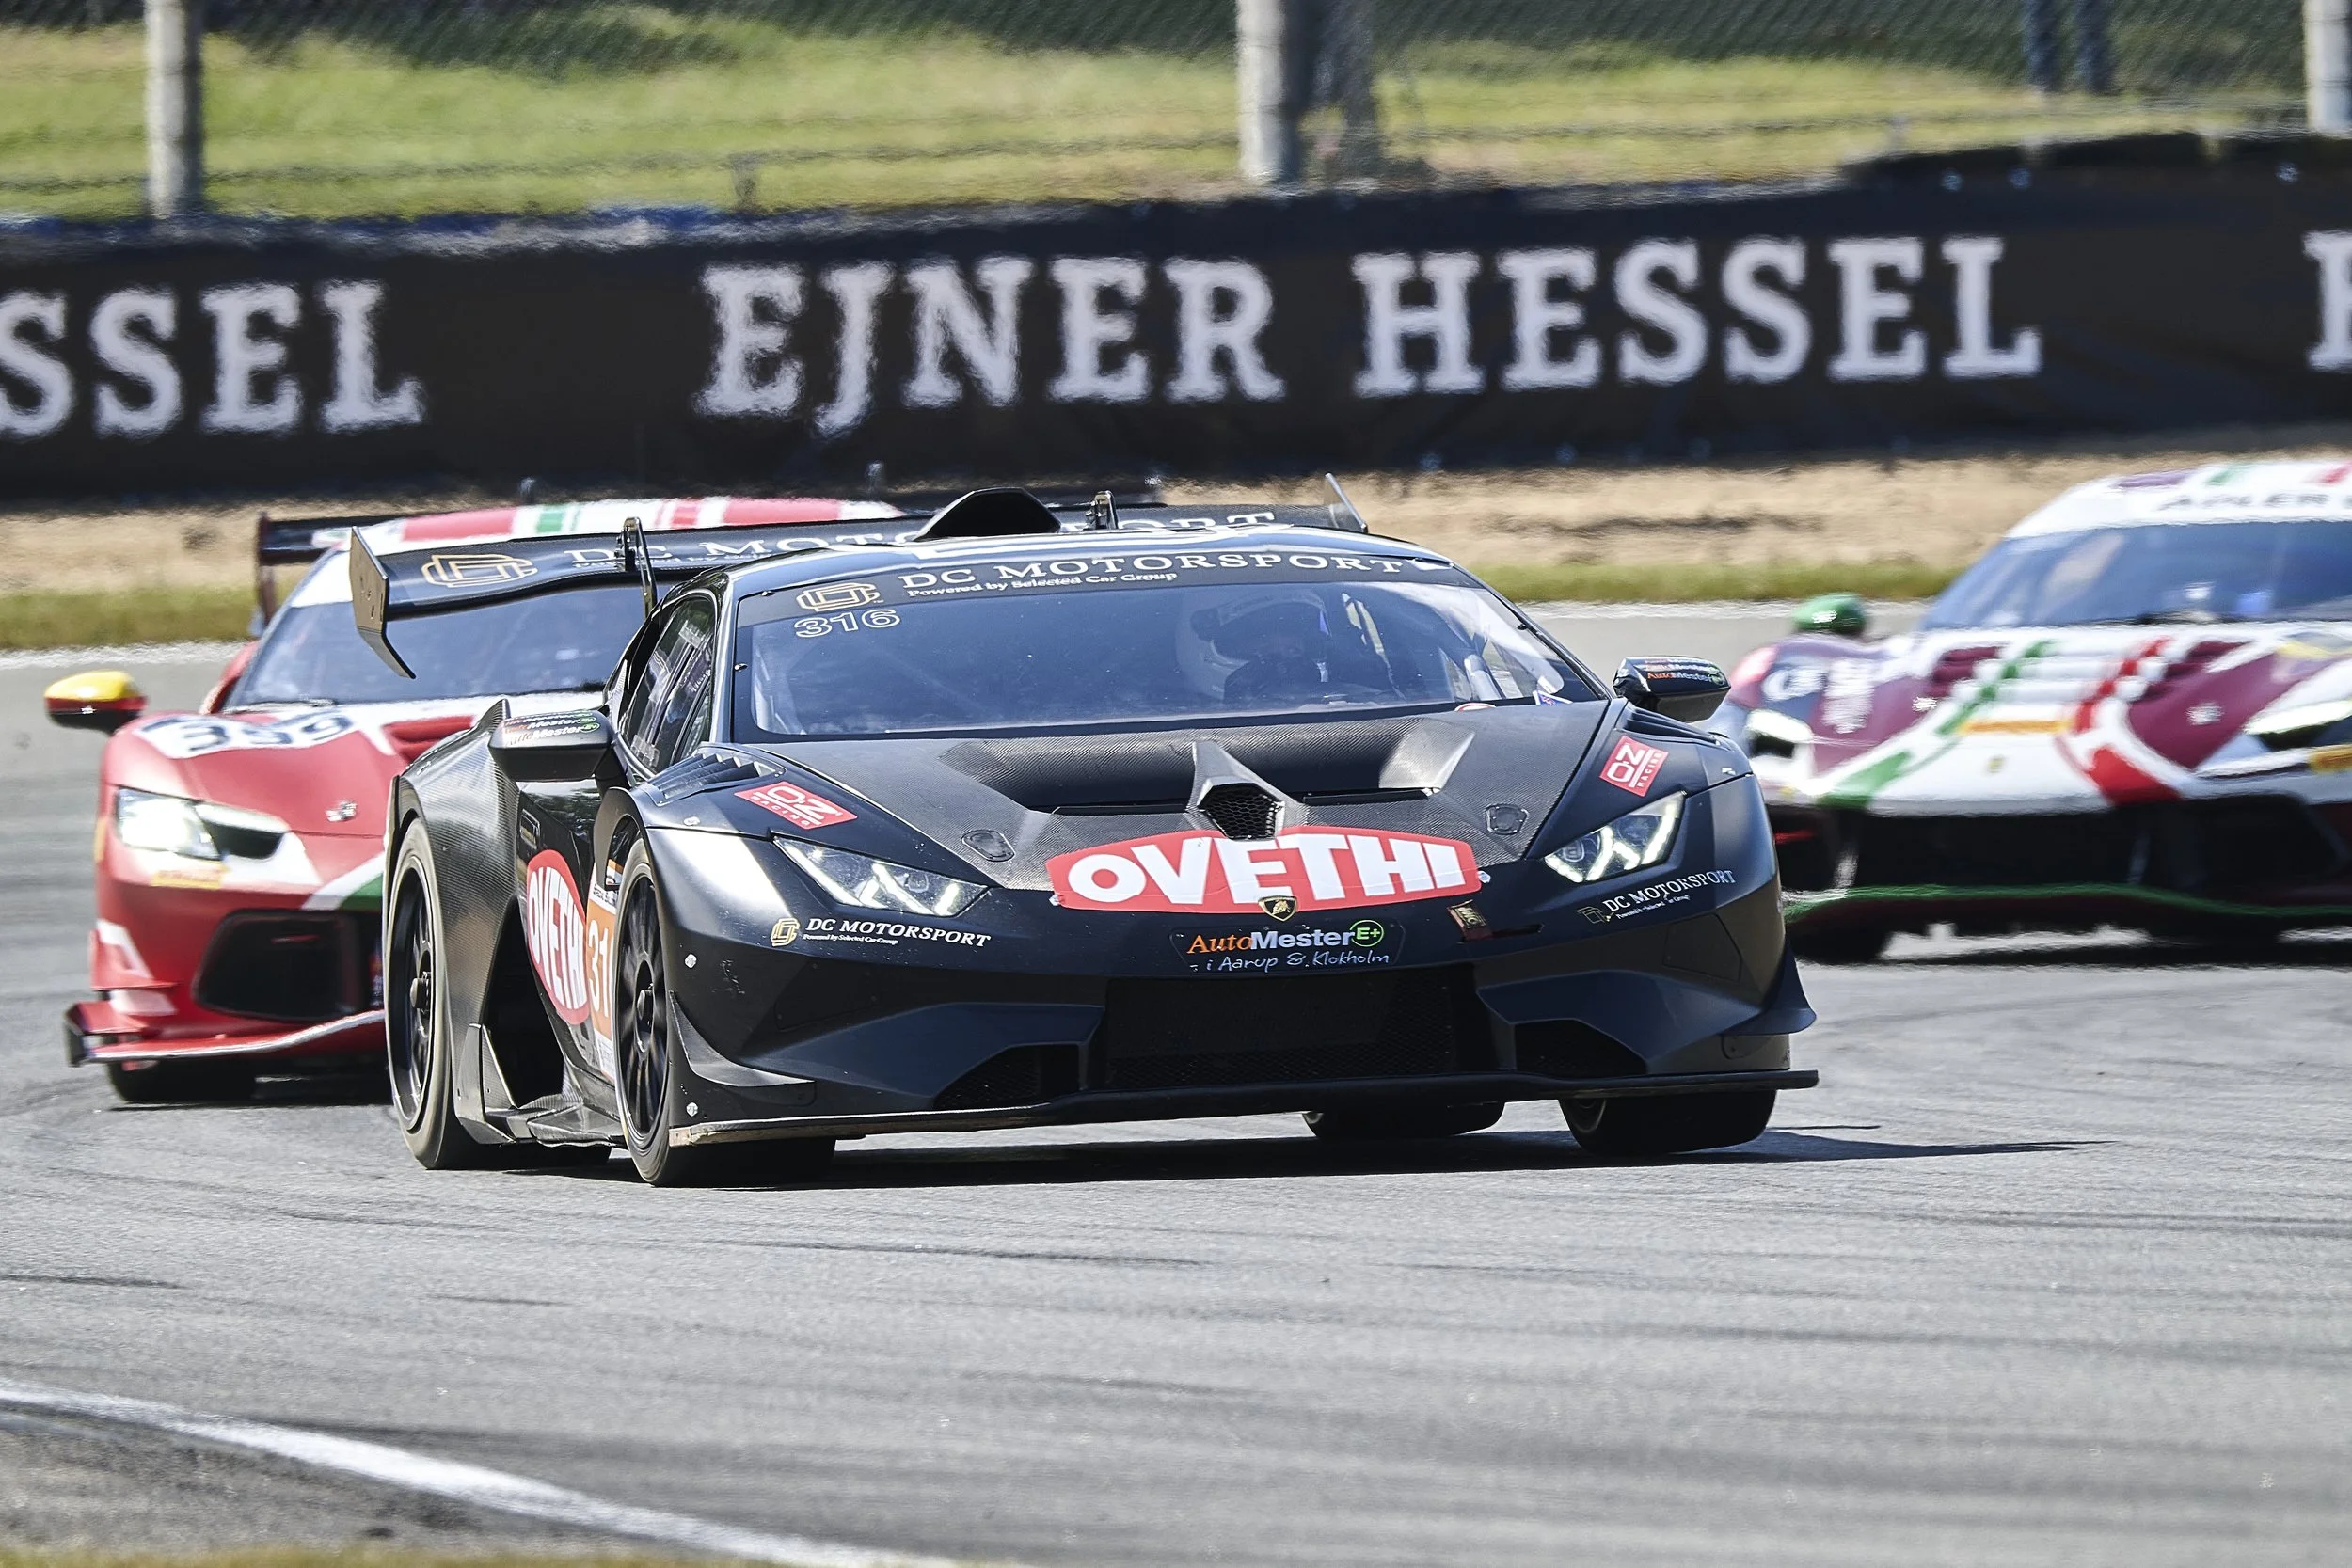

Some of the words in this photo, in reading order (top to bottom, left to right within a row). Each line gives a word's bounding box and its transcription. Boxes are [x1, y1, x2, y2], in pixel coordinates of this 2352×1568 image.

[693, 254, 1286, 438] EJNER
[1352, 235, 2042, 399] HESSEL
[898, 569, 976, 589] DC
[993, 553, 1403, 579] MOTORSPORT
[907, 583, 982, 597] Powered
[986, 580, 1008, 591] by
[1011, 576, 1082, 588] Selected
[1086, 575, 1117, 583] Car
[1120, 572, 1178, 582] Group
[794, 609, 900, 638] 316
[751, 796, 810, 826] RACING
[767, 786, 839, 820] OZ
[1068, 833, 1467, 905] OVETHI
[1602, 895, 1631, 912] DC
[1628, 870, 1736, 904] MOTORSPORT
[528, 866, 588, 1010] OVETHI
[805, 918, 836, 931] DC
[839, 920, 992, 947] MOTORSPORT
[1186, 928, 1356, 954] AutoMester
[588, 919, 613, 1018] 31
[1218, 956, 1279, 973] Aarup
[1311, 950, 1390, 965] Klokholm
